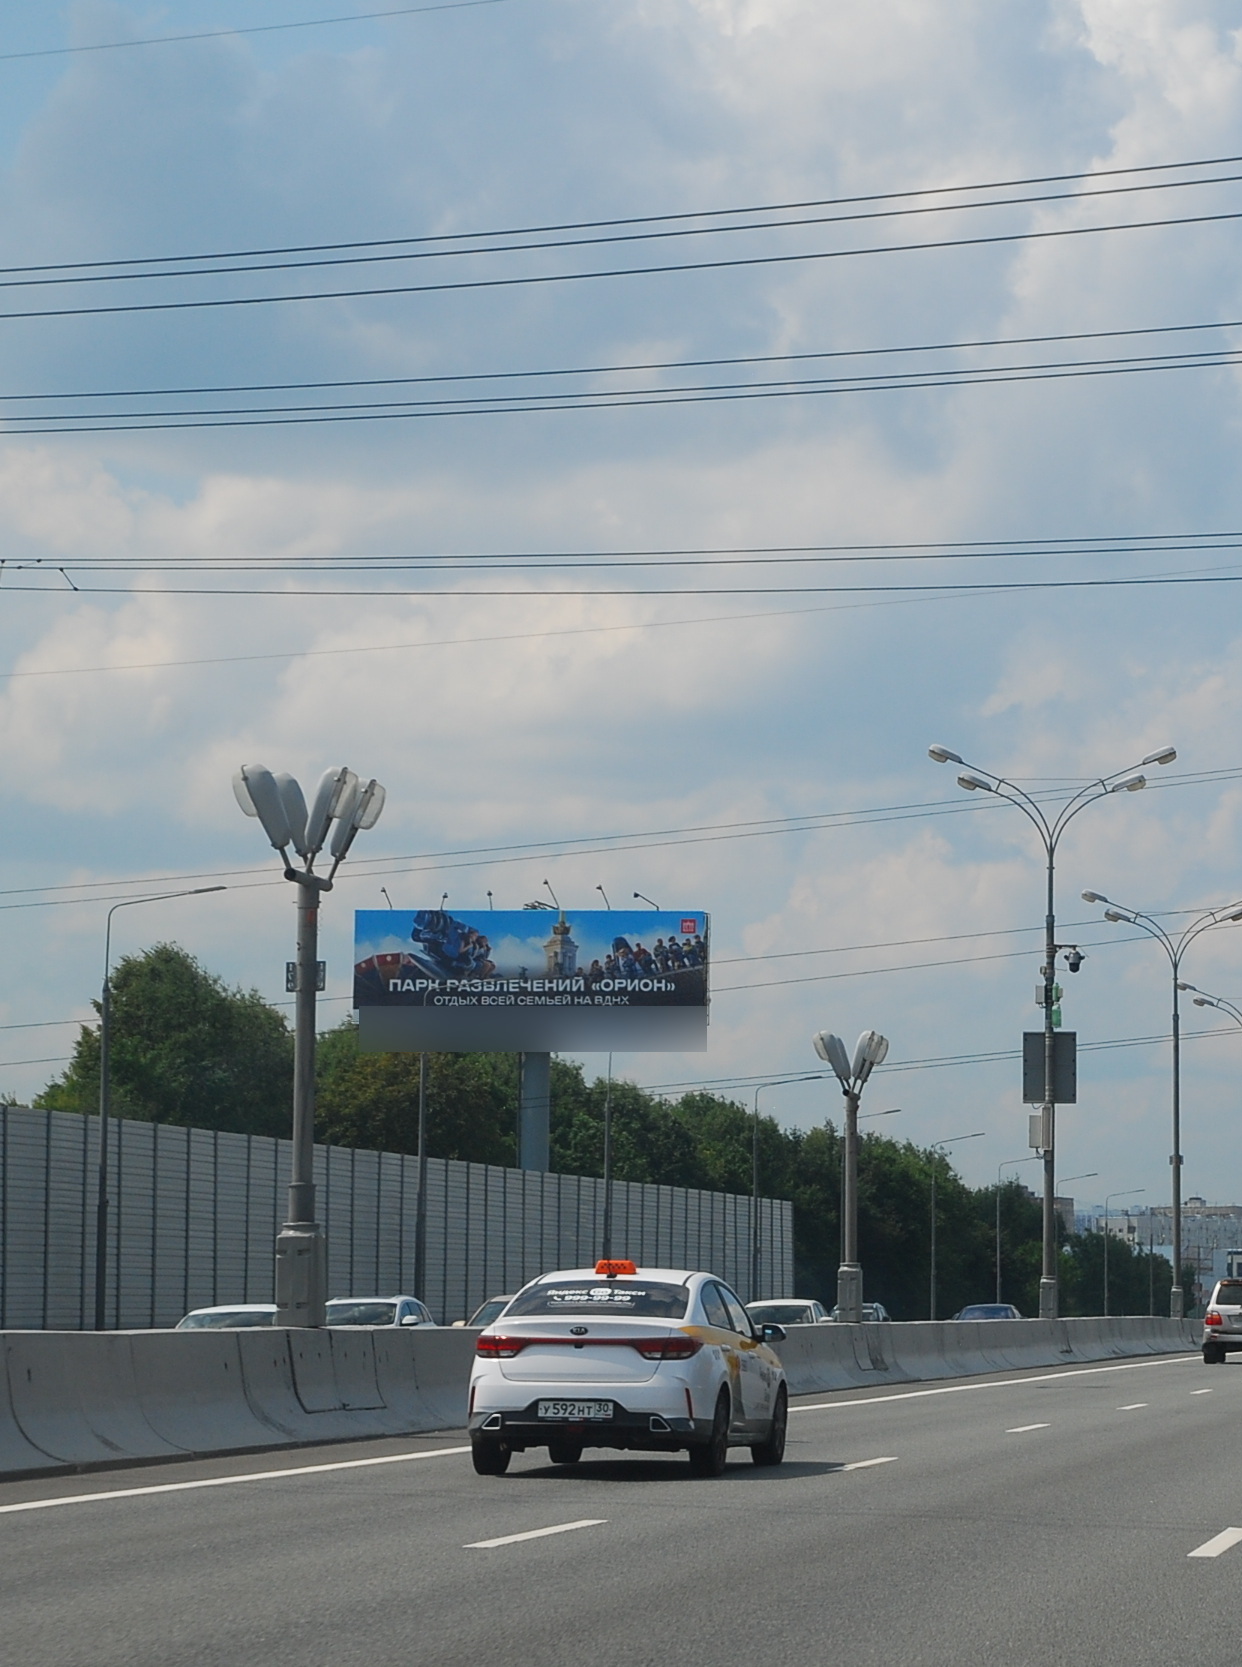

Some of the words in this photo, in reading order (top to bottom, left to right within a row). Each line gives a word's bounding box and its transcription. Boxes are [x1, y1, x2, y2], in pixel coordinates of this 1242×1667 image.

[389, 978, 439, 992] ПАРК
[446, 976, 585, 992] РАЗВЛЕЧЕНИЙ
[591, 979, 675, 992] «ОРИОН»
[433, 995, 479, 1006] ОТДЫХ
[480, 994, 515, 1005] ВСЕЙ
[517, 994, 572, 1005] СЕМЬЕЙ
[574, 996, 592, 1005] НА
[594, 995, 629, 1006] ВДНХ
[543, 1403, 593, 1416] У592НТ
[596, 1403, 609, 1413] 30
